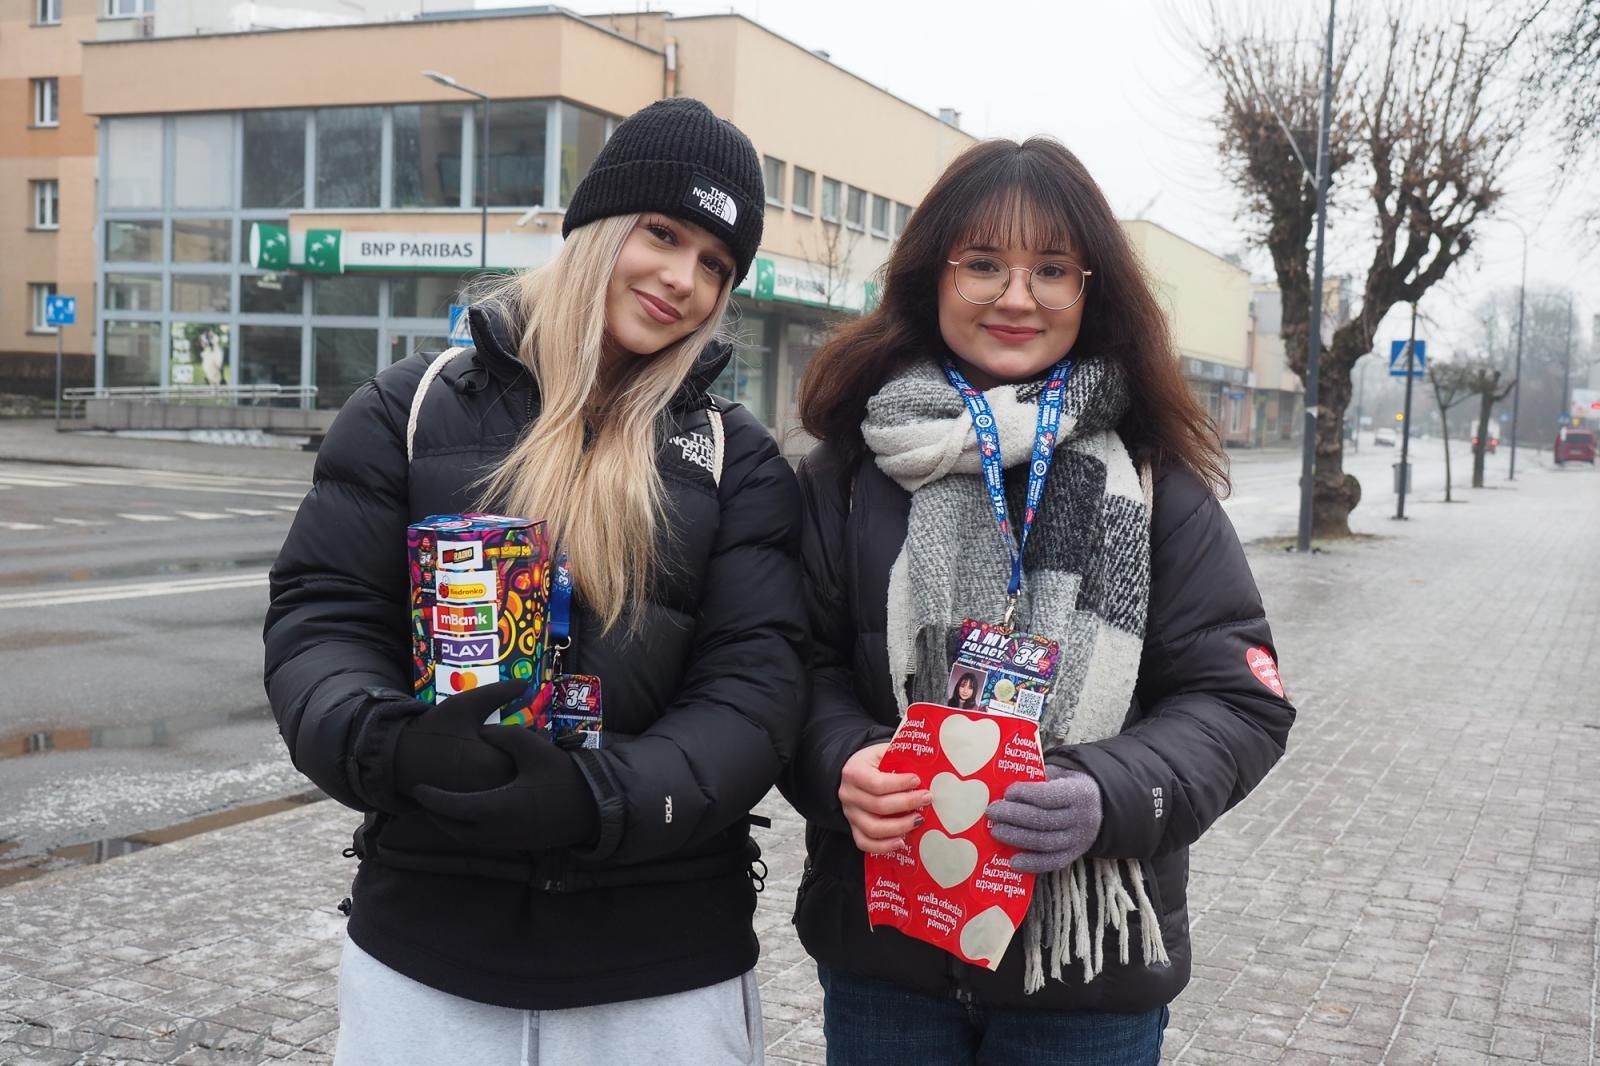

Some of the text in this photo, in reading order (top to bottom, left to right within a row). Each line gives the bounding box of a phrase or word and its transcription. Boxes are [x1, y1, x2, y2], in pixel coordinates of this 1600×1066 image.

[692, 186, 725, 209] NORTH
[710, 186, 728, 202] THE
[699, 199, 722, 217] FACE
[361, 242, 473, 257] BNP PARIBAS
[669, 436, 714, 461] NORTH
[690, 431, 714, 450] THE
[981, 432, 997, 452] 34
[682, 448, 714, 473] FACE
[993, 494, 1005, 515] 112
[558, 565, 570, 586] 34
[440, 612, 488, 626] mBank
[966, 628, 981, 642] A
[982, 632, 1012, 650] MY,
[441, 643, 488, 658] PLAY
[961, 640, 1006, 661] POLACY,
[1013, 647, 1047, 666] 34
[566, 686, 590, 708] 34
[1012, 732, 1037, 750] pomocy
[998, 759, 1025, 774] orkiestra
[665, 795, 673, 824] 700
[990, 854, 1010, 868] mocy
[876, 876, 900, 892] pomocy
[982, 863, 1023, 886] świątecznej
[870, 886, 905, 908] świątecznej
[976, 879, 1026, 898] wielka orkiestra
[891, 903, 909, 918] wielka
[917, 892, 963, 918] wielka orkiestra
[920, 903, 957, 930] świątecznej
[926, 918, 951, 937] pomocy
